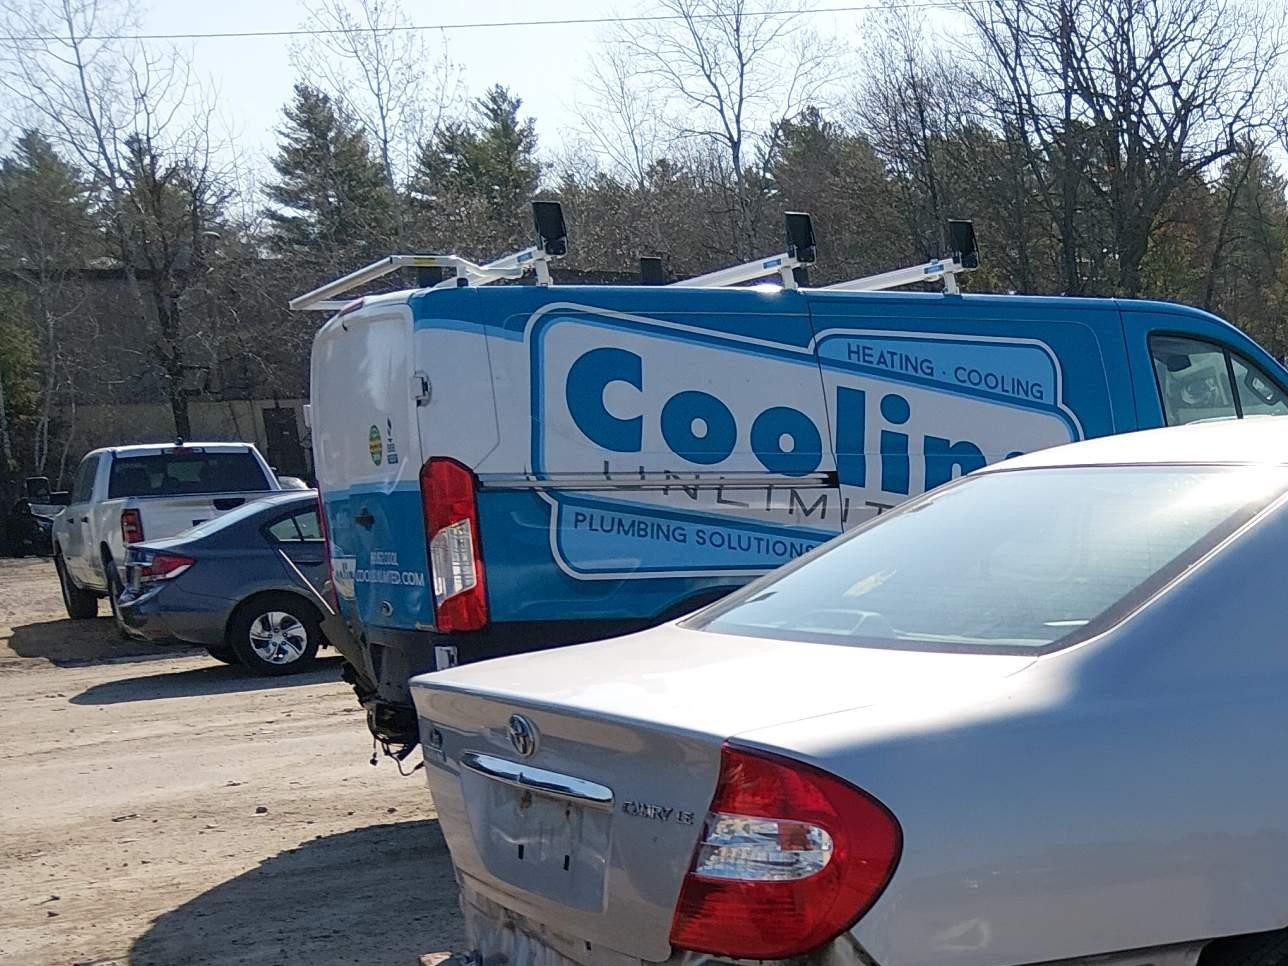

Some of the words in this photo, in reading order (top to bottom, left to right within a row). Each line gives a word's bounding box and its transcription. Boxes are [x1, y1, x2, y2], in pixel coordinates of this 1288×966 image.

[847, 343, 934, 377] HEATING
[953, 366, 1044, 401] COOLING
[566, 347, 1024, 495] Coolin
[574, 511, 688, 544] PLUMBING
